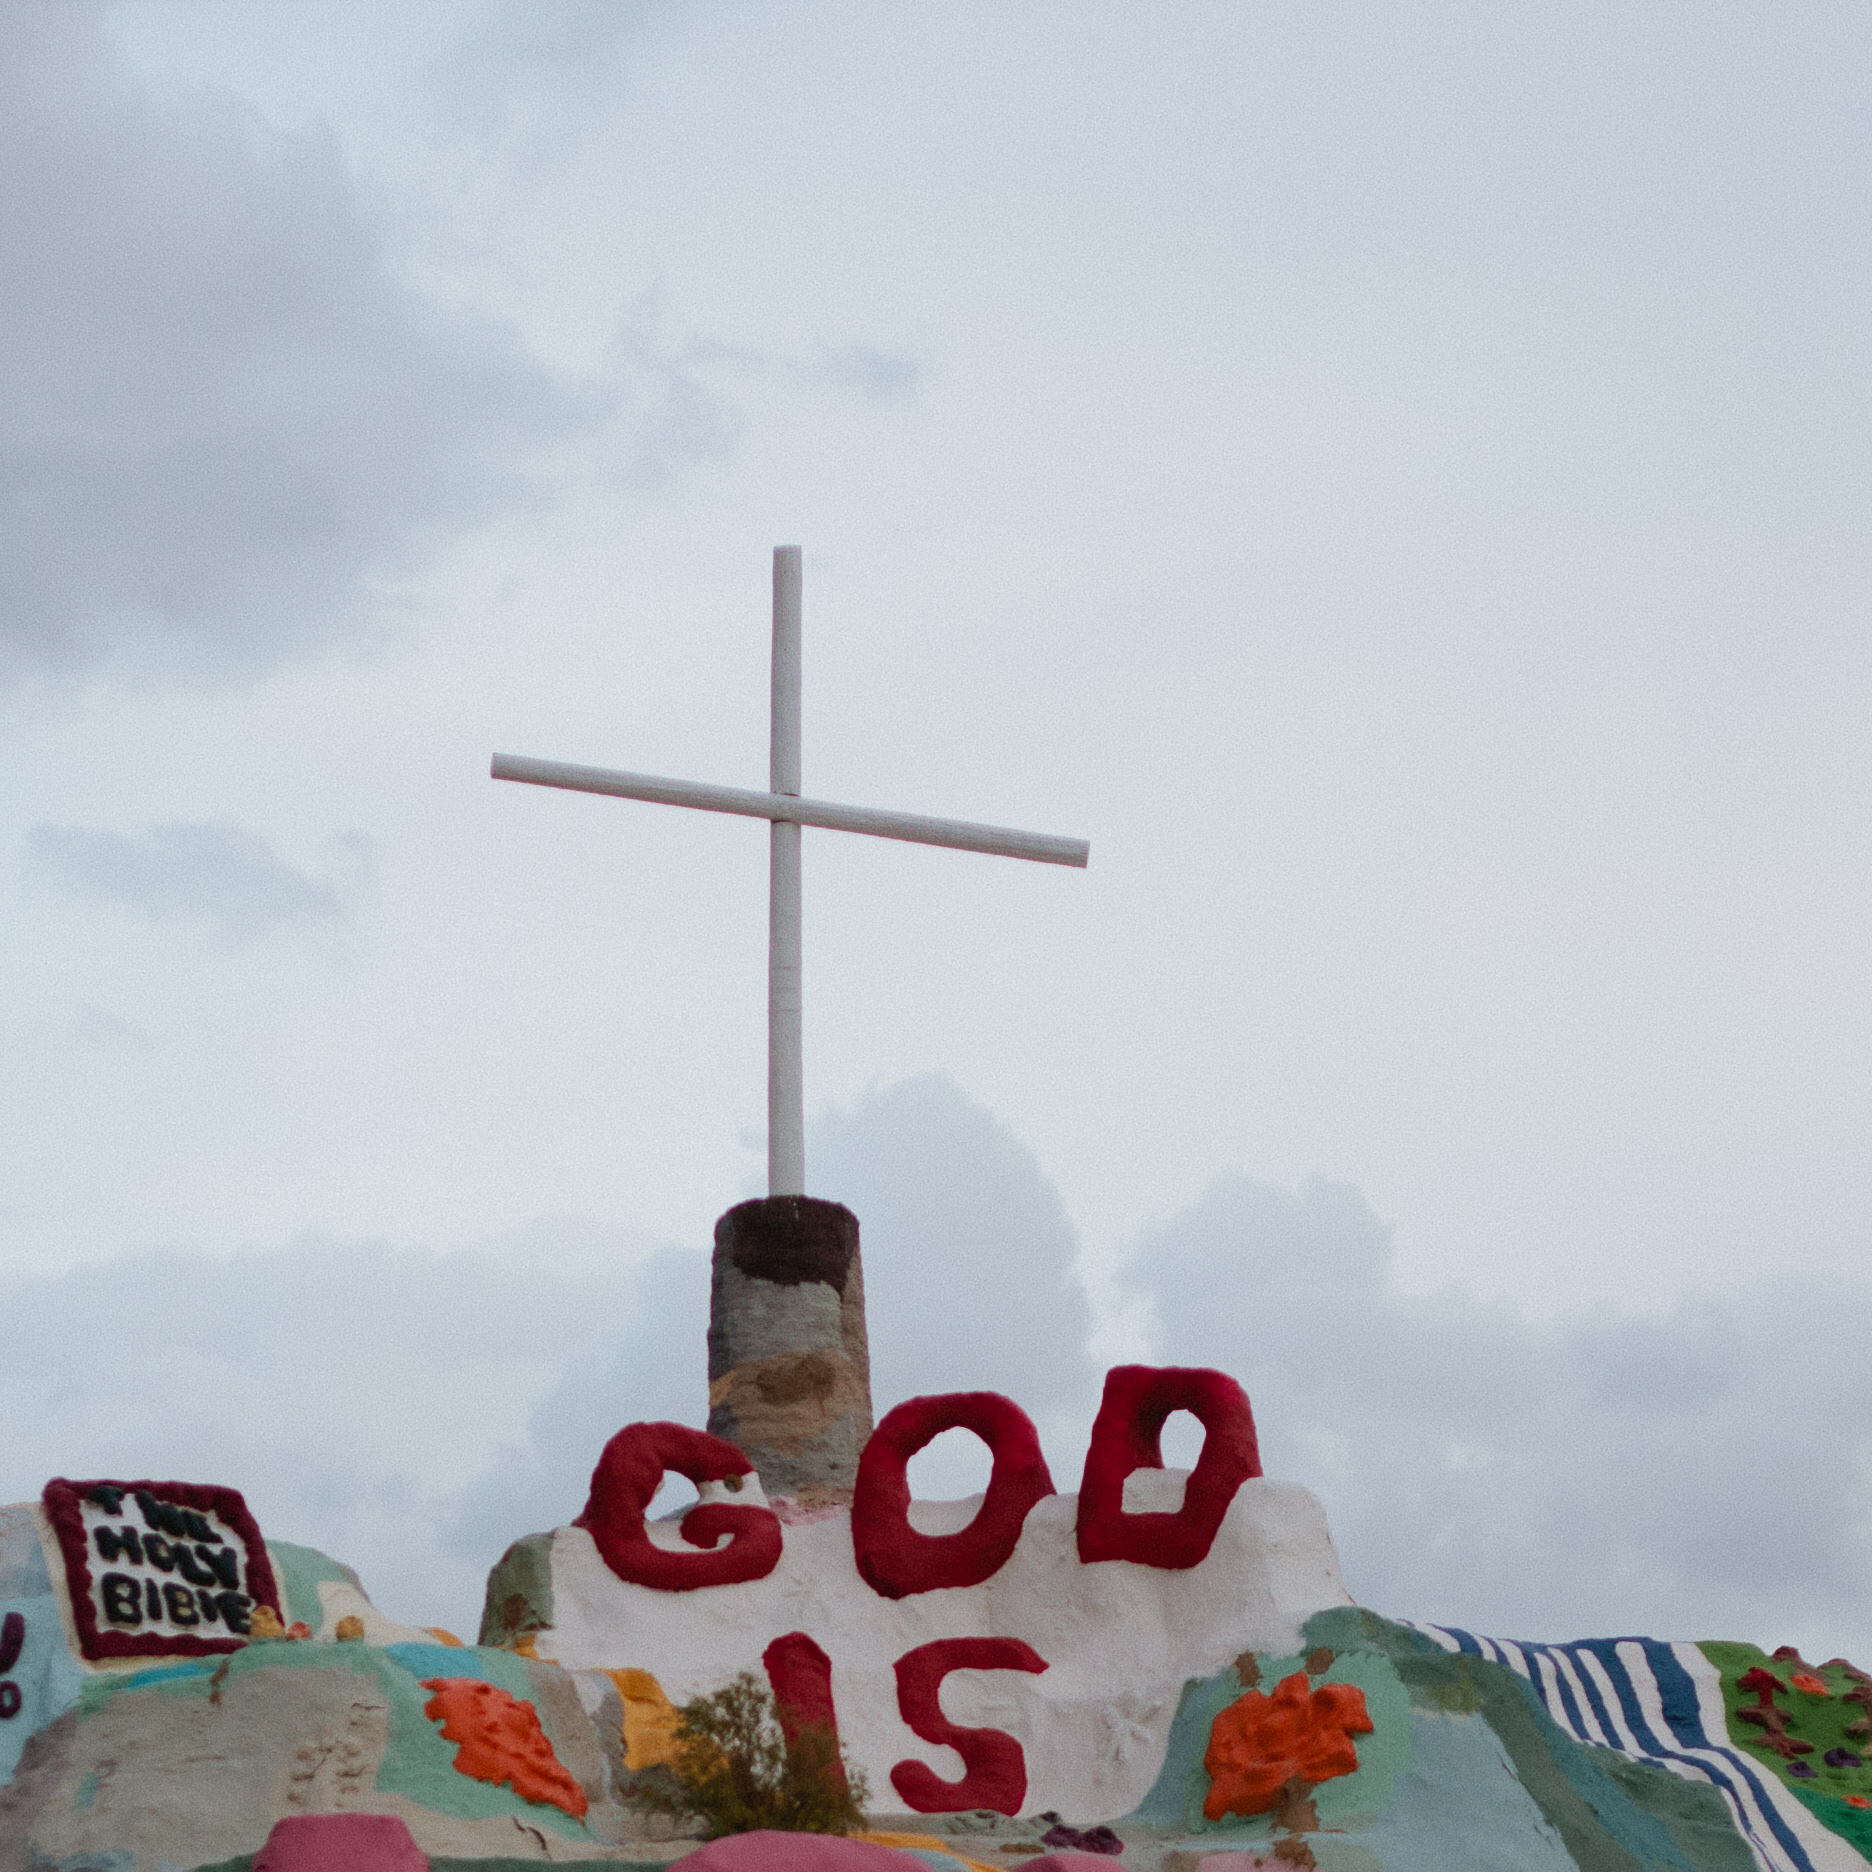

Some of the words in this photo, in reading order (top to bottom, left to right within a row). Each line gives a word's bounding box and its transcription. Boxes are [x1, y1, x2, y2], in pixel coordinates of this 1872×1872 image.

[581, 1365, 1260, 1598] GOD
[94, 1525, 240, 1590] HOLY
[101, 1571, 253, 1635] BIBLE
[764, 1632, 1049, 1815] IS
